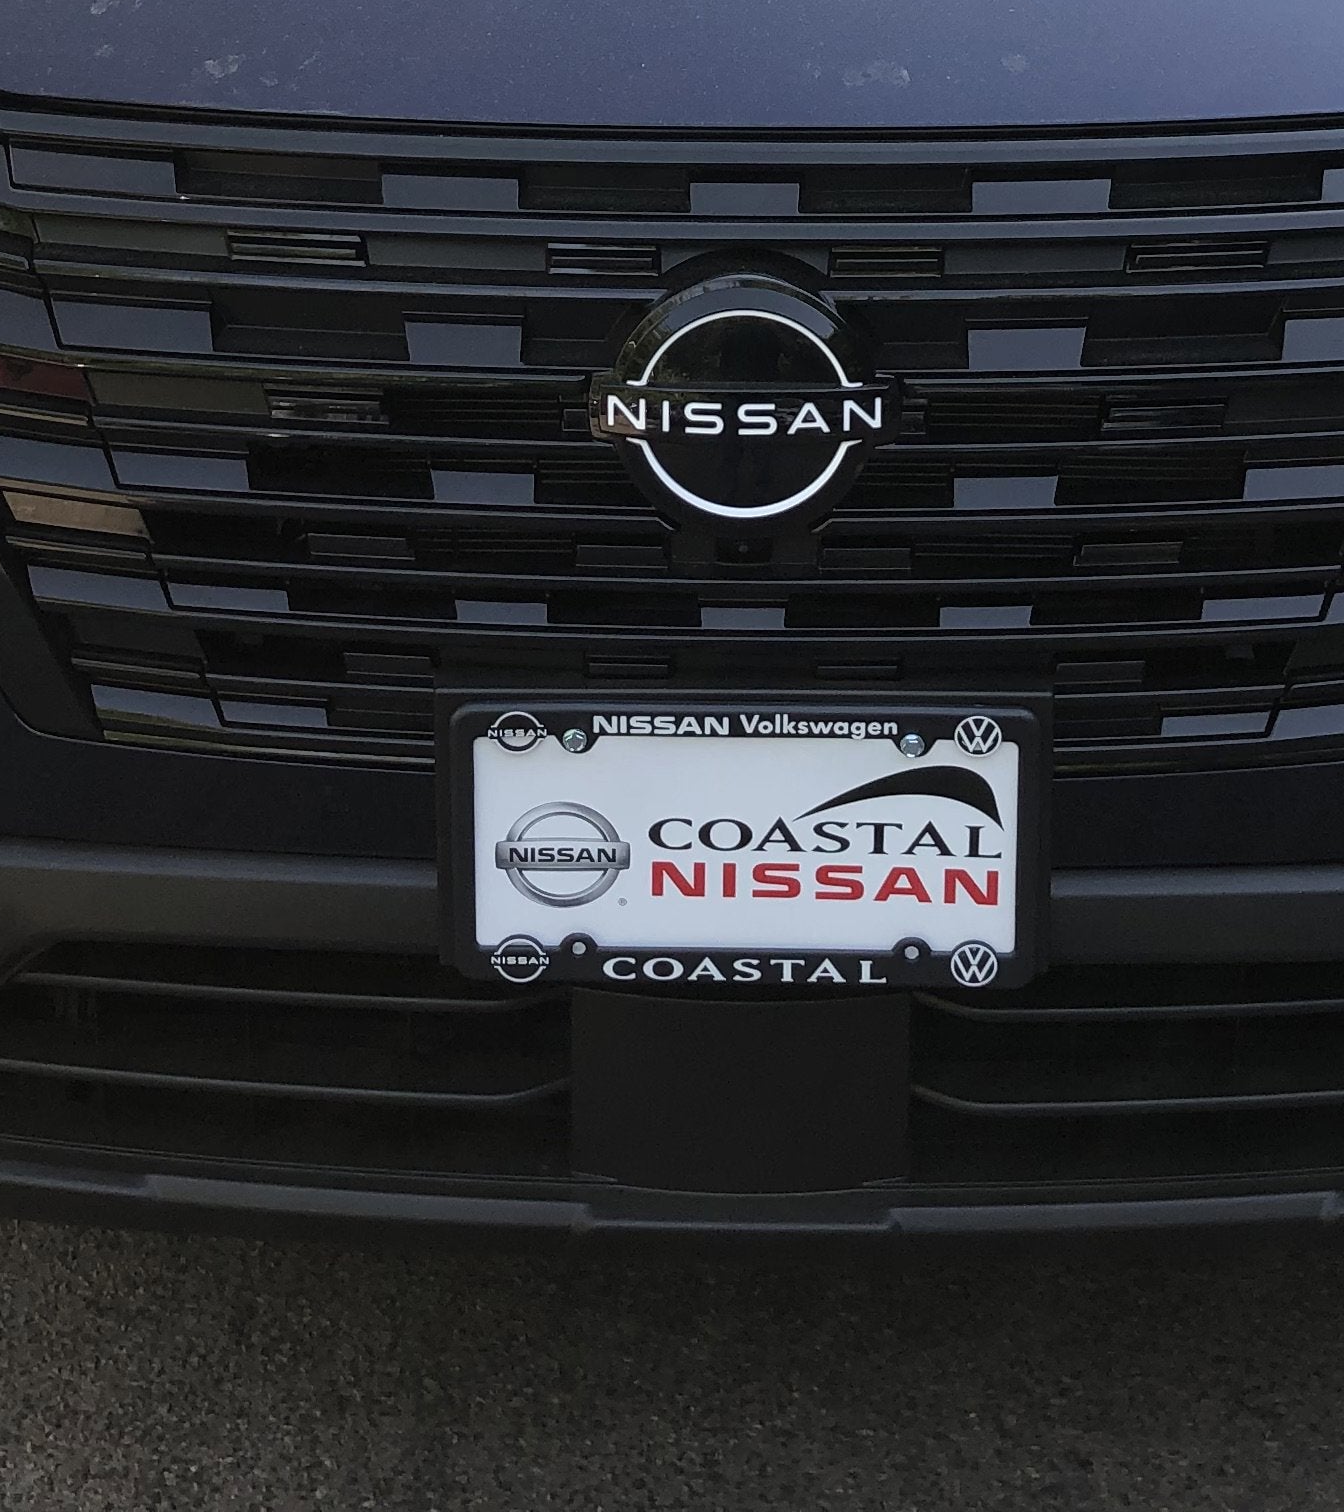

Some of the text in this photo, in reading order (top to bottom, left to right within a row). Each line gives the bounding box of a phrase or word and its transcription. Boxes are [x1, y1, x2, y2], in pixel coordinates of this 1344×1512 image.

[606, 394, 883, 436] NISSAN
[487, 728, 548, 738] NISSAN
[592, 713, 899, 740] NISSAN Volkswagen
[647, 816, 1004, 860] COASTAL
[508, 846, 618, 865] NISSAN
[651, 861, 1000, 906] NISSAN
[490, 955, 550, 966] NISSAN
[602, 957, 888, 984] COASTAL
